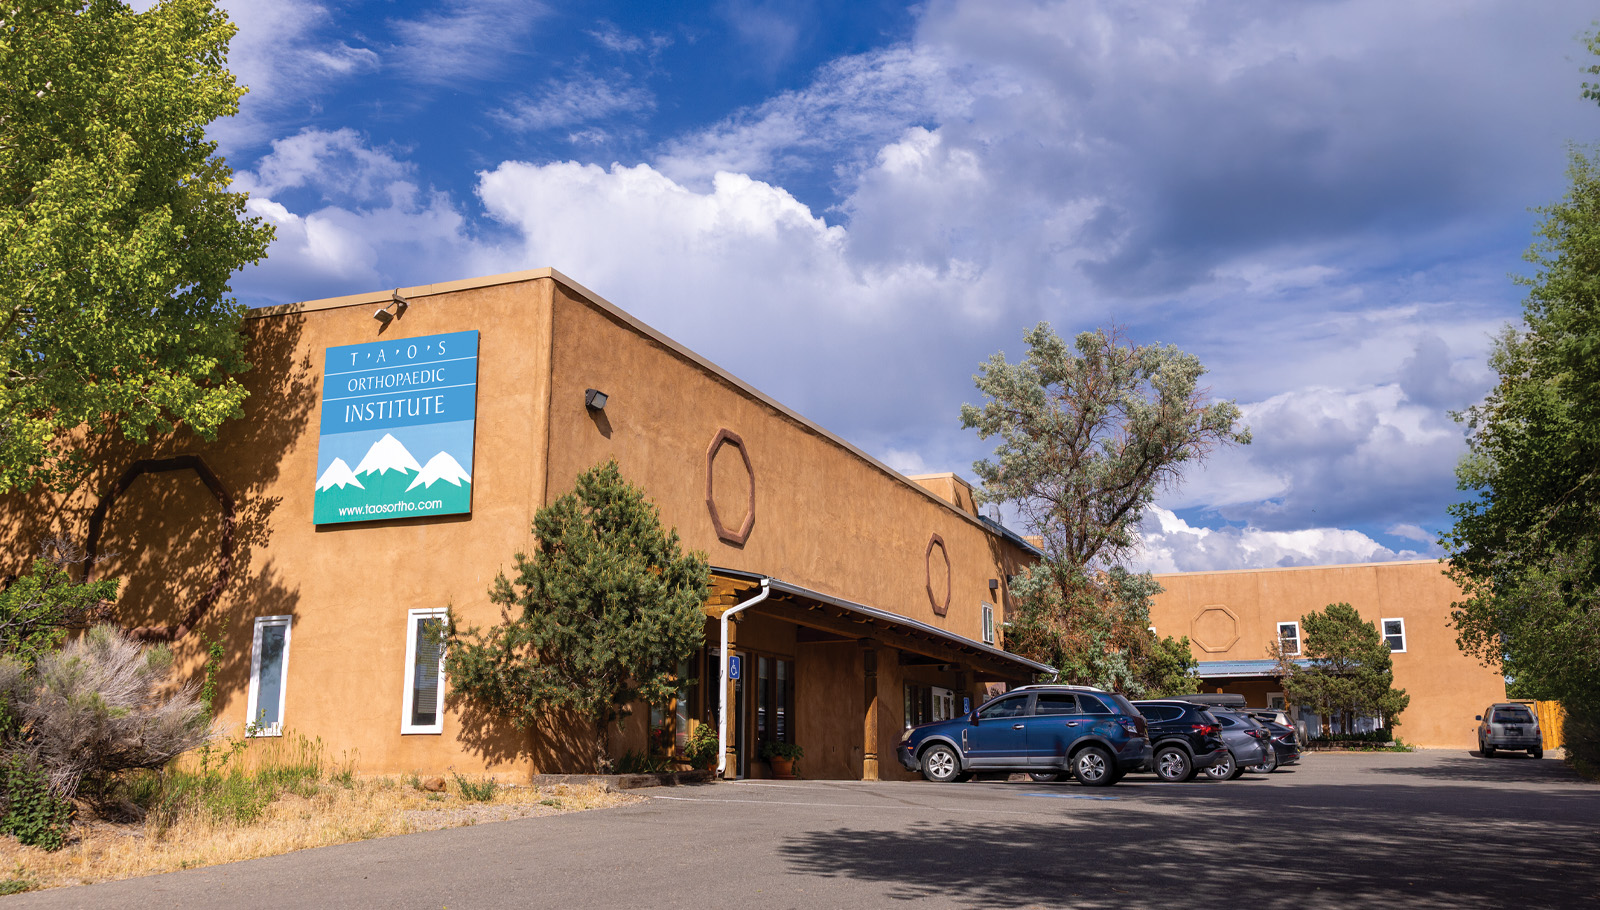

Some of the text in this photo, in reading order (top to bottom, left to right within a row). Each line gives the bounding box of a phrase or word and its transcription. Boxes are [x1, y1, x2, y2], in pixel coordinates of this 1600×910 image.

[348, 368, 445, 392] ORTHOPAEDIC
[345, 395, 445, 423] INSTITUTE
[338, 498, 443, 517] www.taosortho.com
